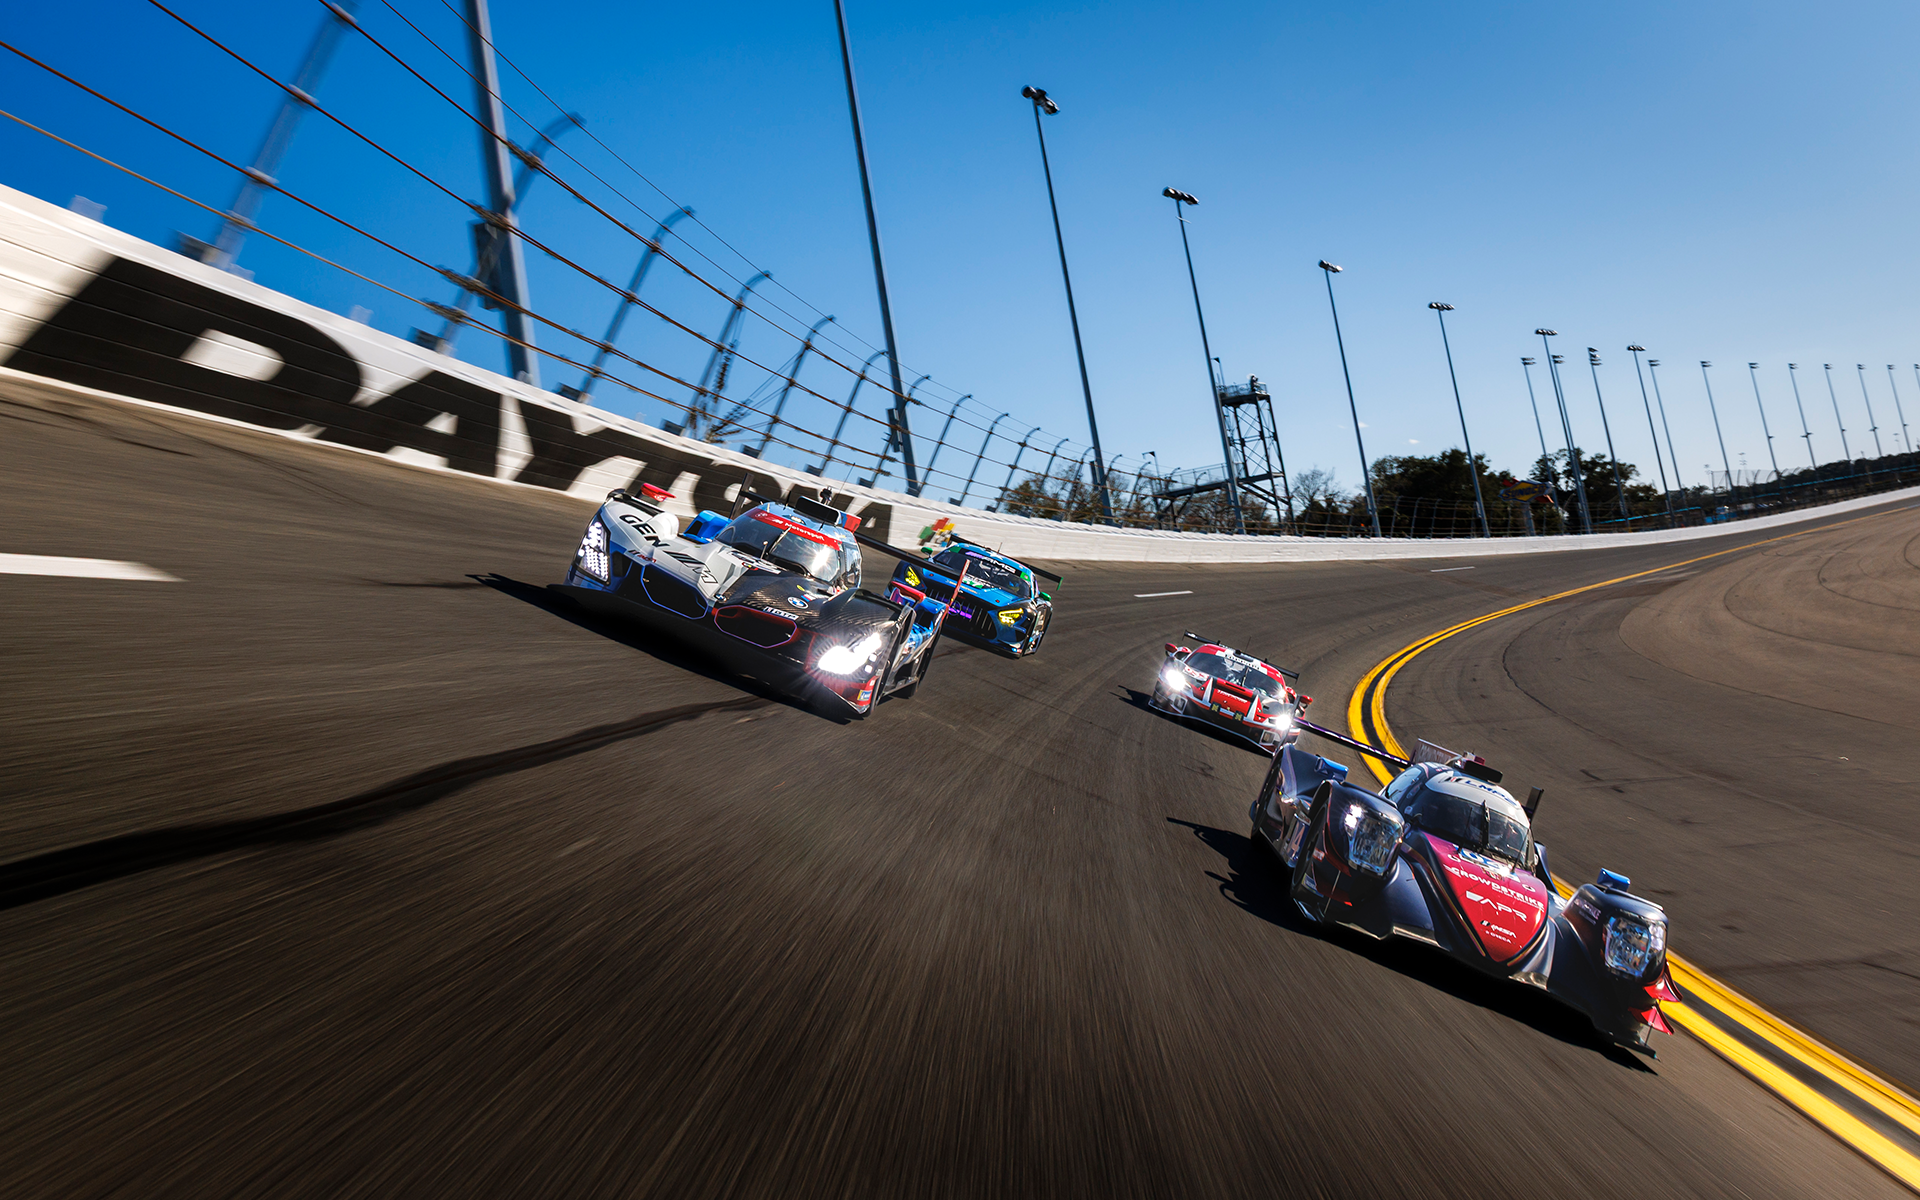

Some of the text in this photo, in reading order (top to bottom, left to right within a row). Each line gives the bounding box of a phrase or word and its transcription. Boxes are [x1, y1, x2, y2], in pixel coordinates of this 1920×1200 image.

[619, 514, 670, 548] GEN
[784, 521, 825, 541] Motorsport
[982, 556, 1016, 573] AMG
[1449, 866, 1545, 908] CROWDSTRIKE
